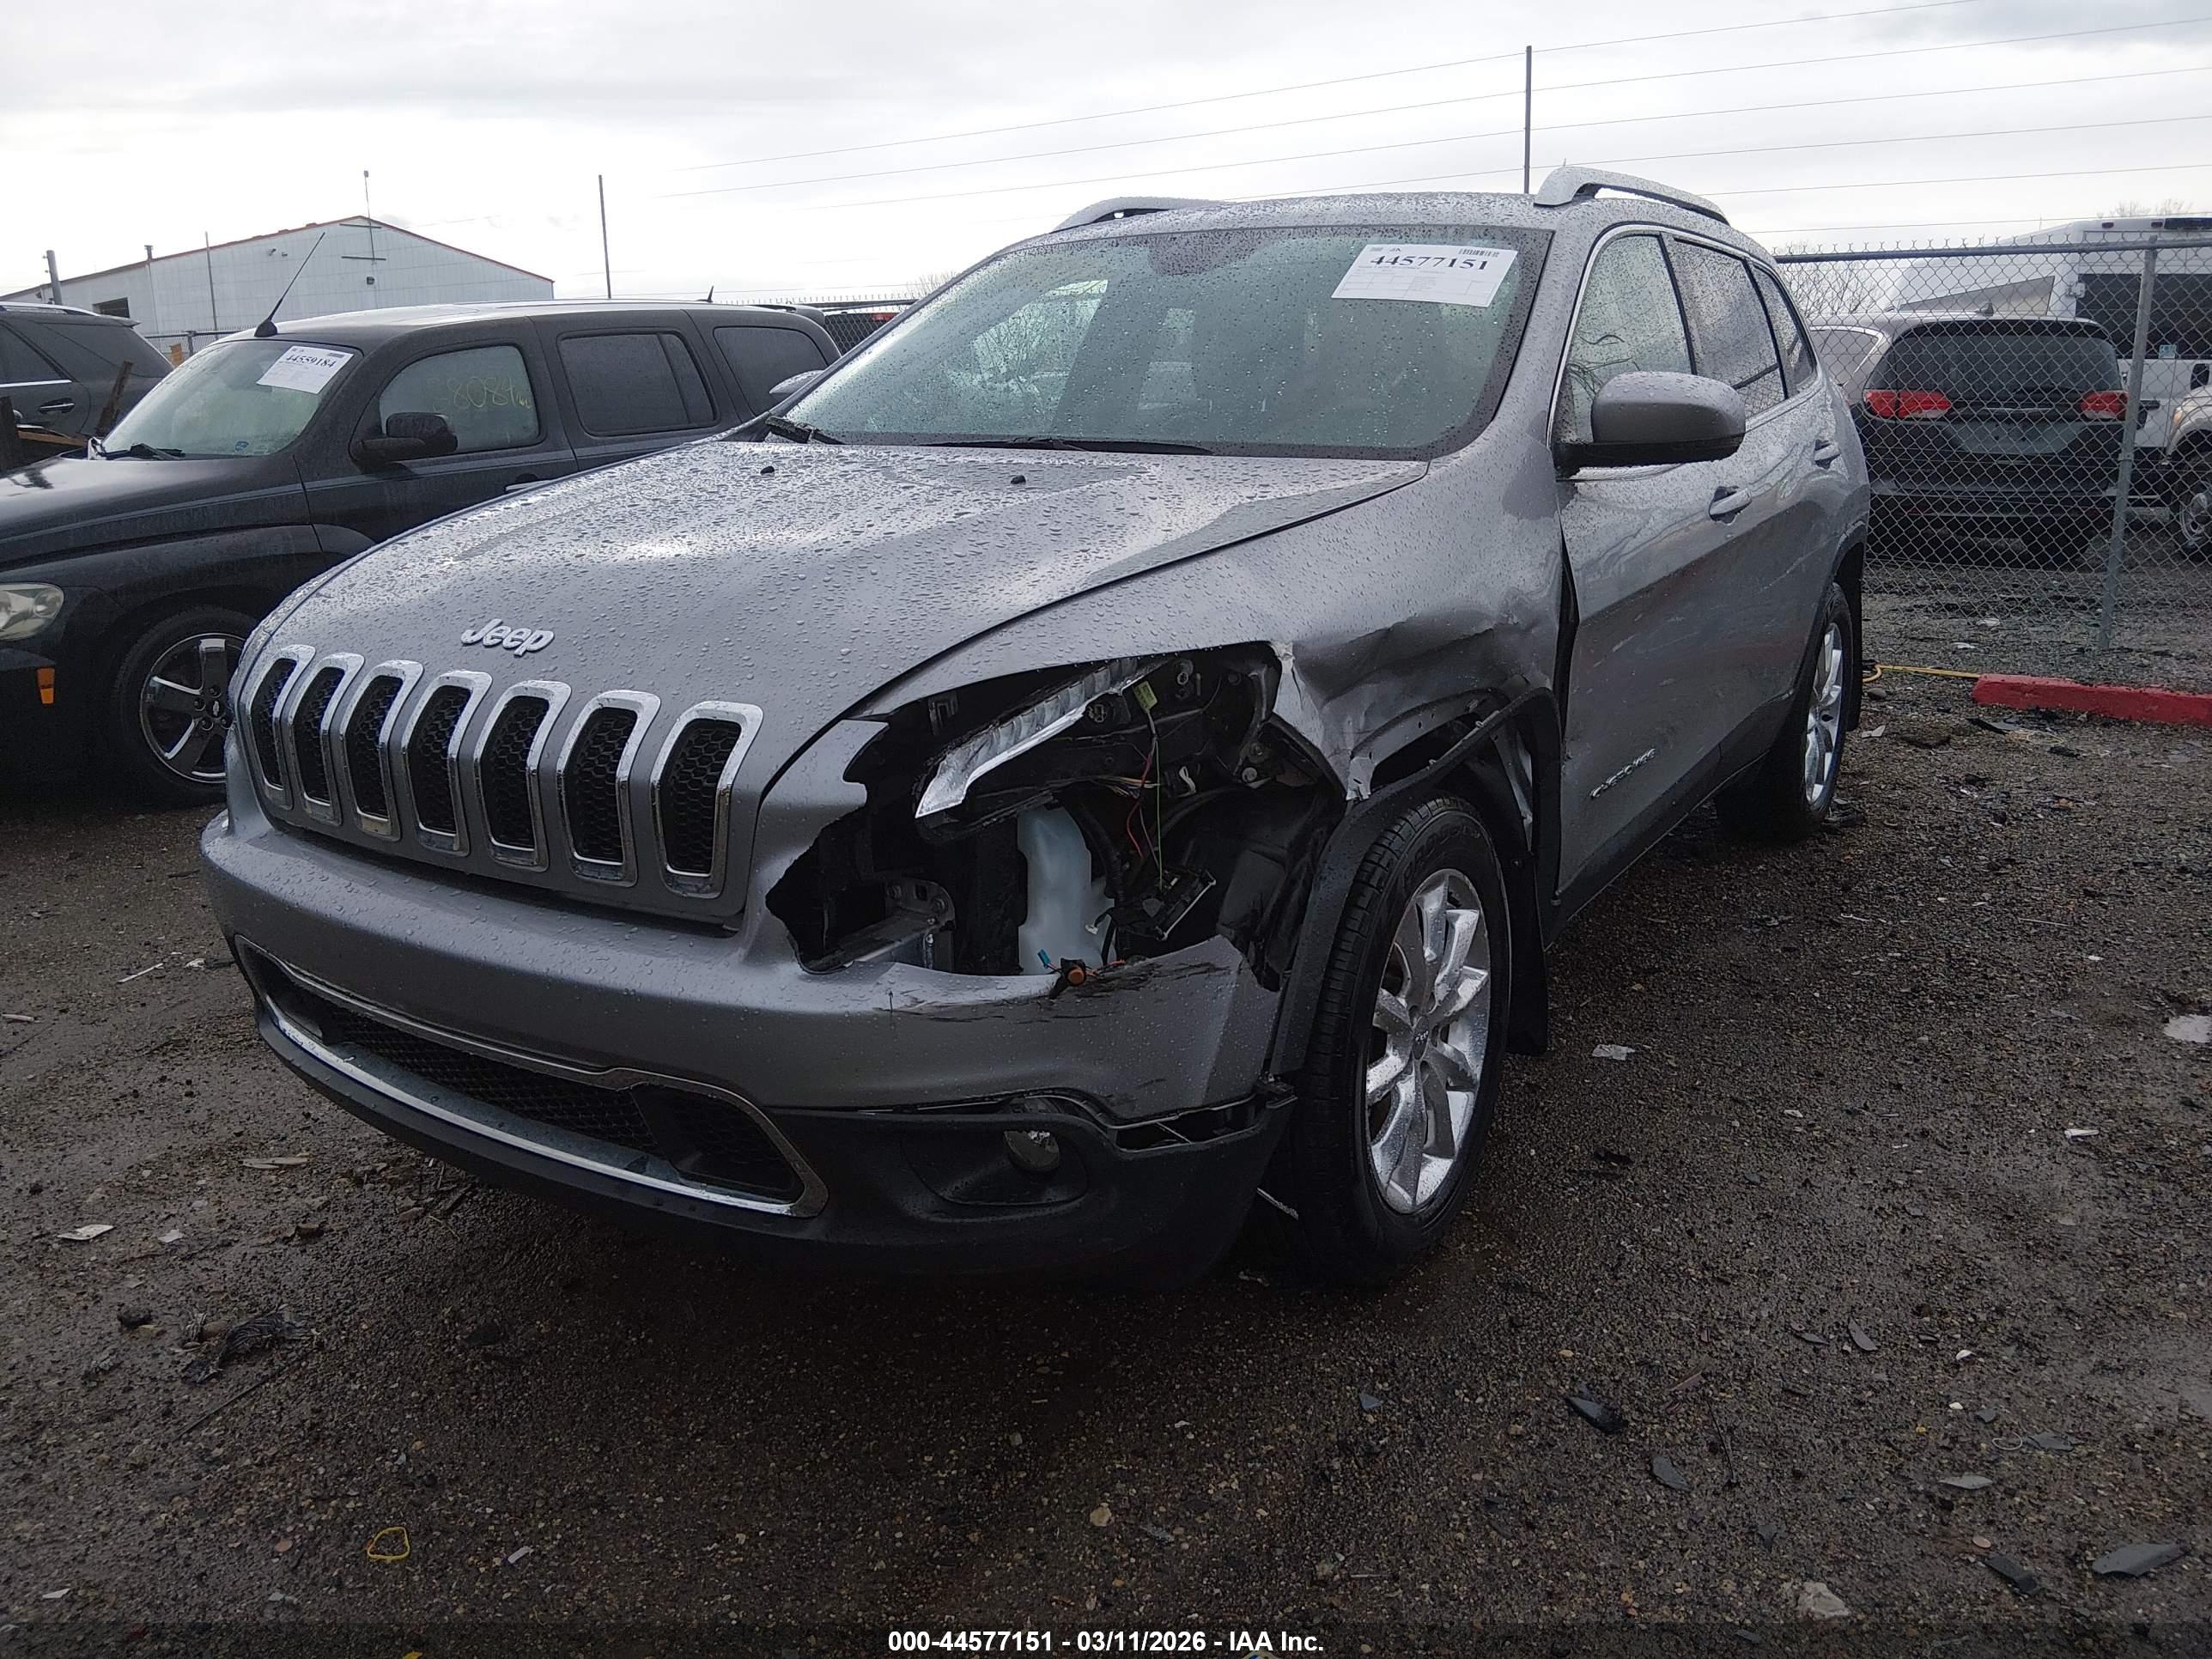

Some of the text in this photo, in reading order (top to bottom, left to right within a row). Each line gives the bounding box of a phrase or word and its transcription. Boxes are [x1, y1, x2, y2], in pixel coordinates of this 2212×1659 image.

[1370, 255, 1488, 270] 44577151
[286, 354, 337, 368] 44559184
[460, 618, 555, 657] Jeep
